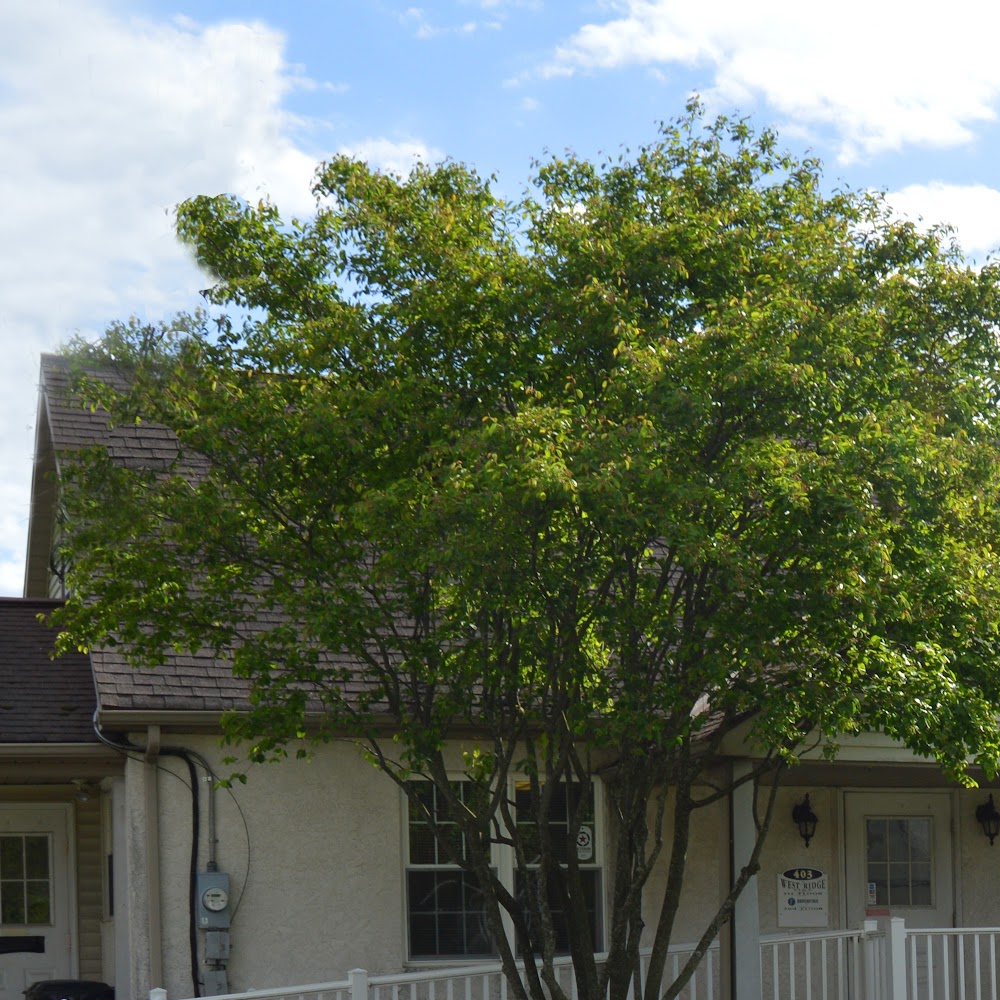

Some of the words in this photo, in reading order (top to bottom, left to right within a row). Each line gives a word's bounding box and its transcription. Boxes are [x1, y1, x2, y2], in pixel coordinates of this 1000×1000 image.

[793, 869, 813, 879] 403
[780, 878, 800, 889] WEST
[803, 879, 826, 889] RIDGE
